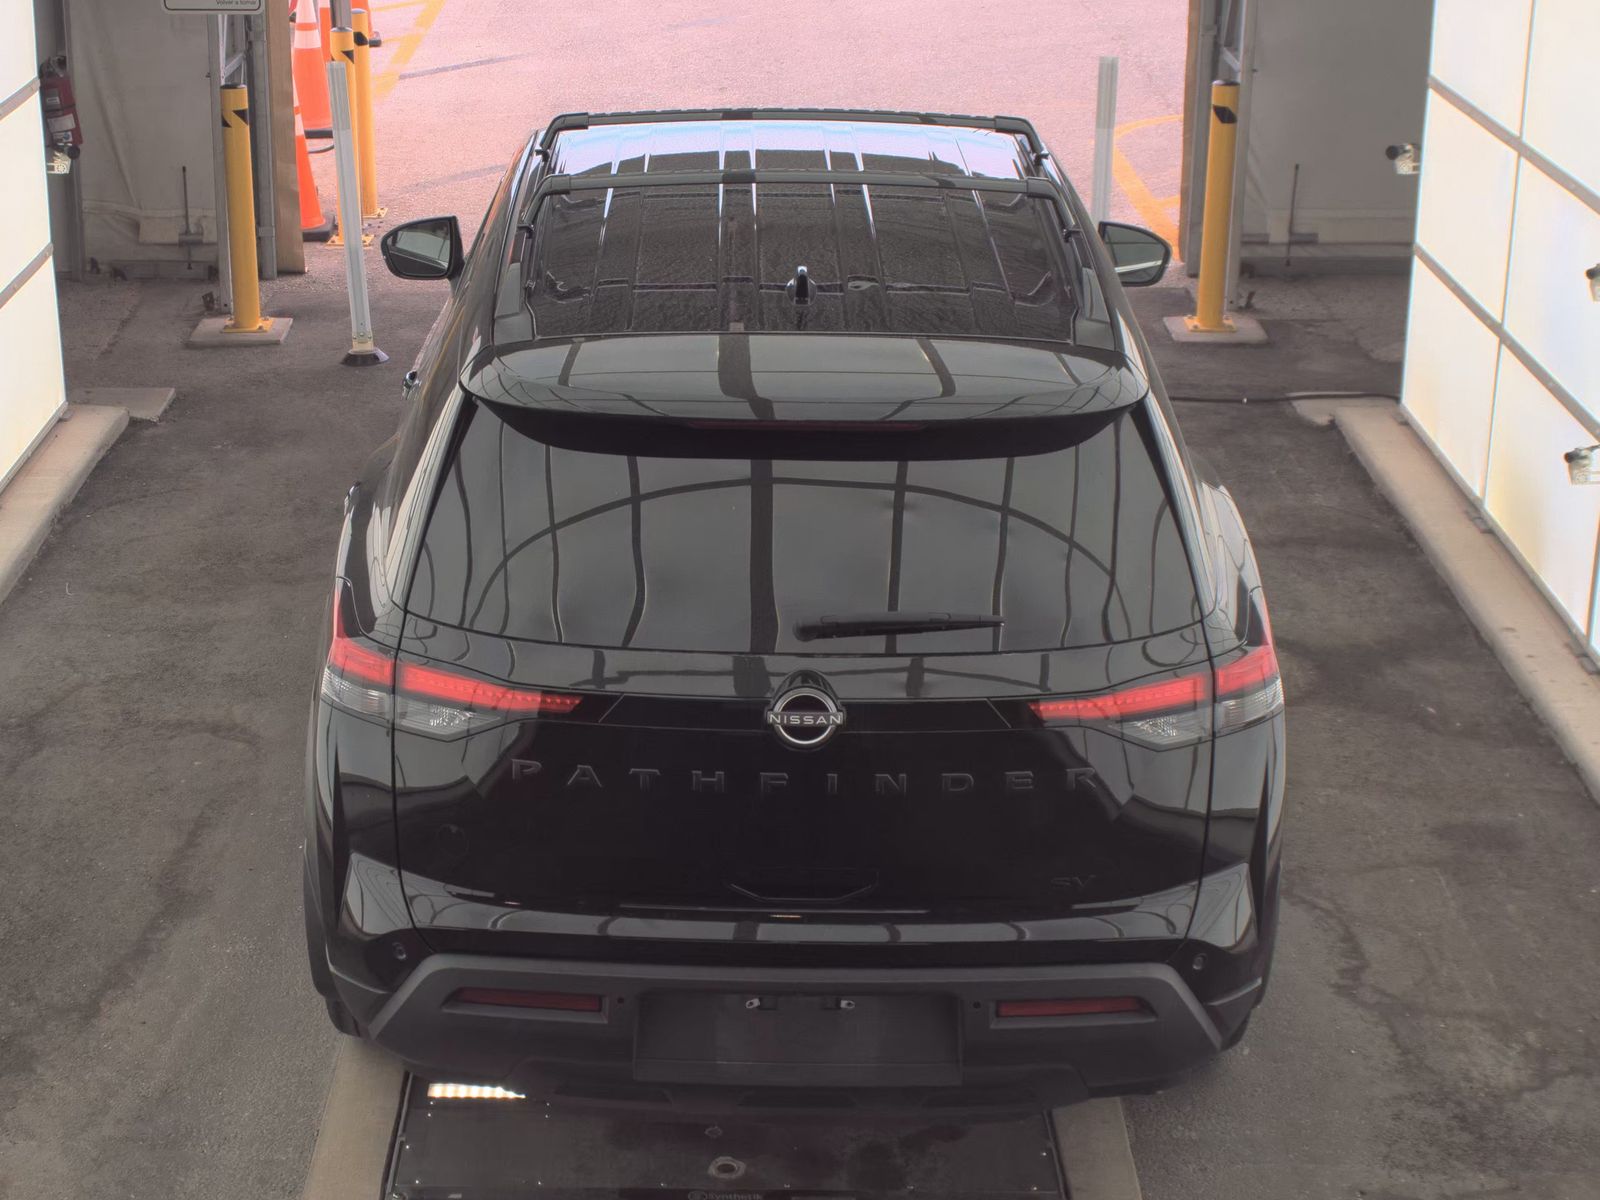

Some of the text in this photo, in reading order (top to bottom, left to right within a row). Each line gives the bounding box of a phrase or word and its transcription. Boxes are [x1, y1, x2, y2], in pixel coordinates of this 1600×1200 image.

[769, 714, 841, 725] NISSAN
[509, 757, 1099, 793] PATHFINDER
[1050, 874, 1097, 889] SV
